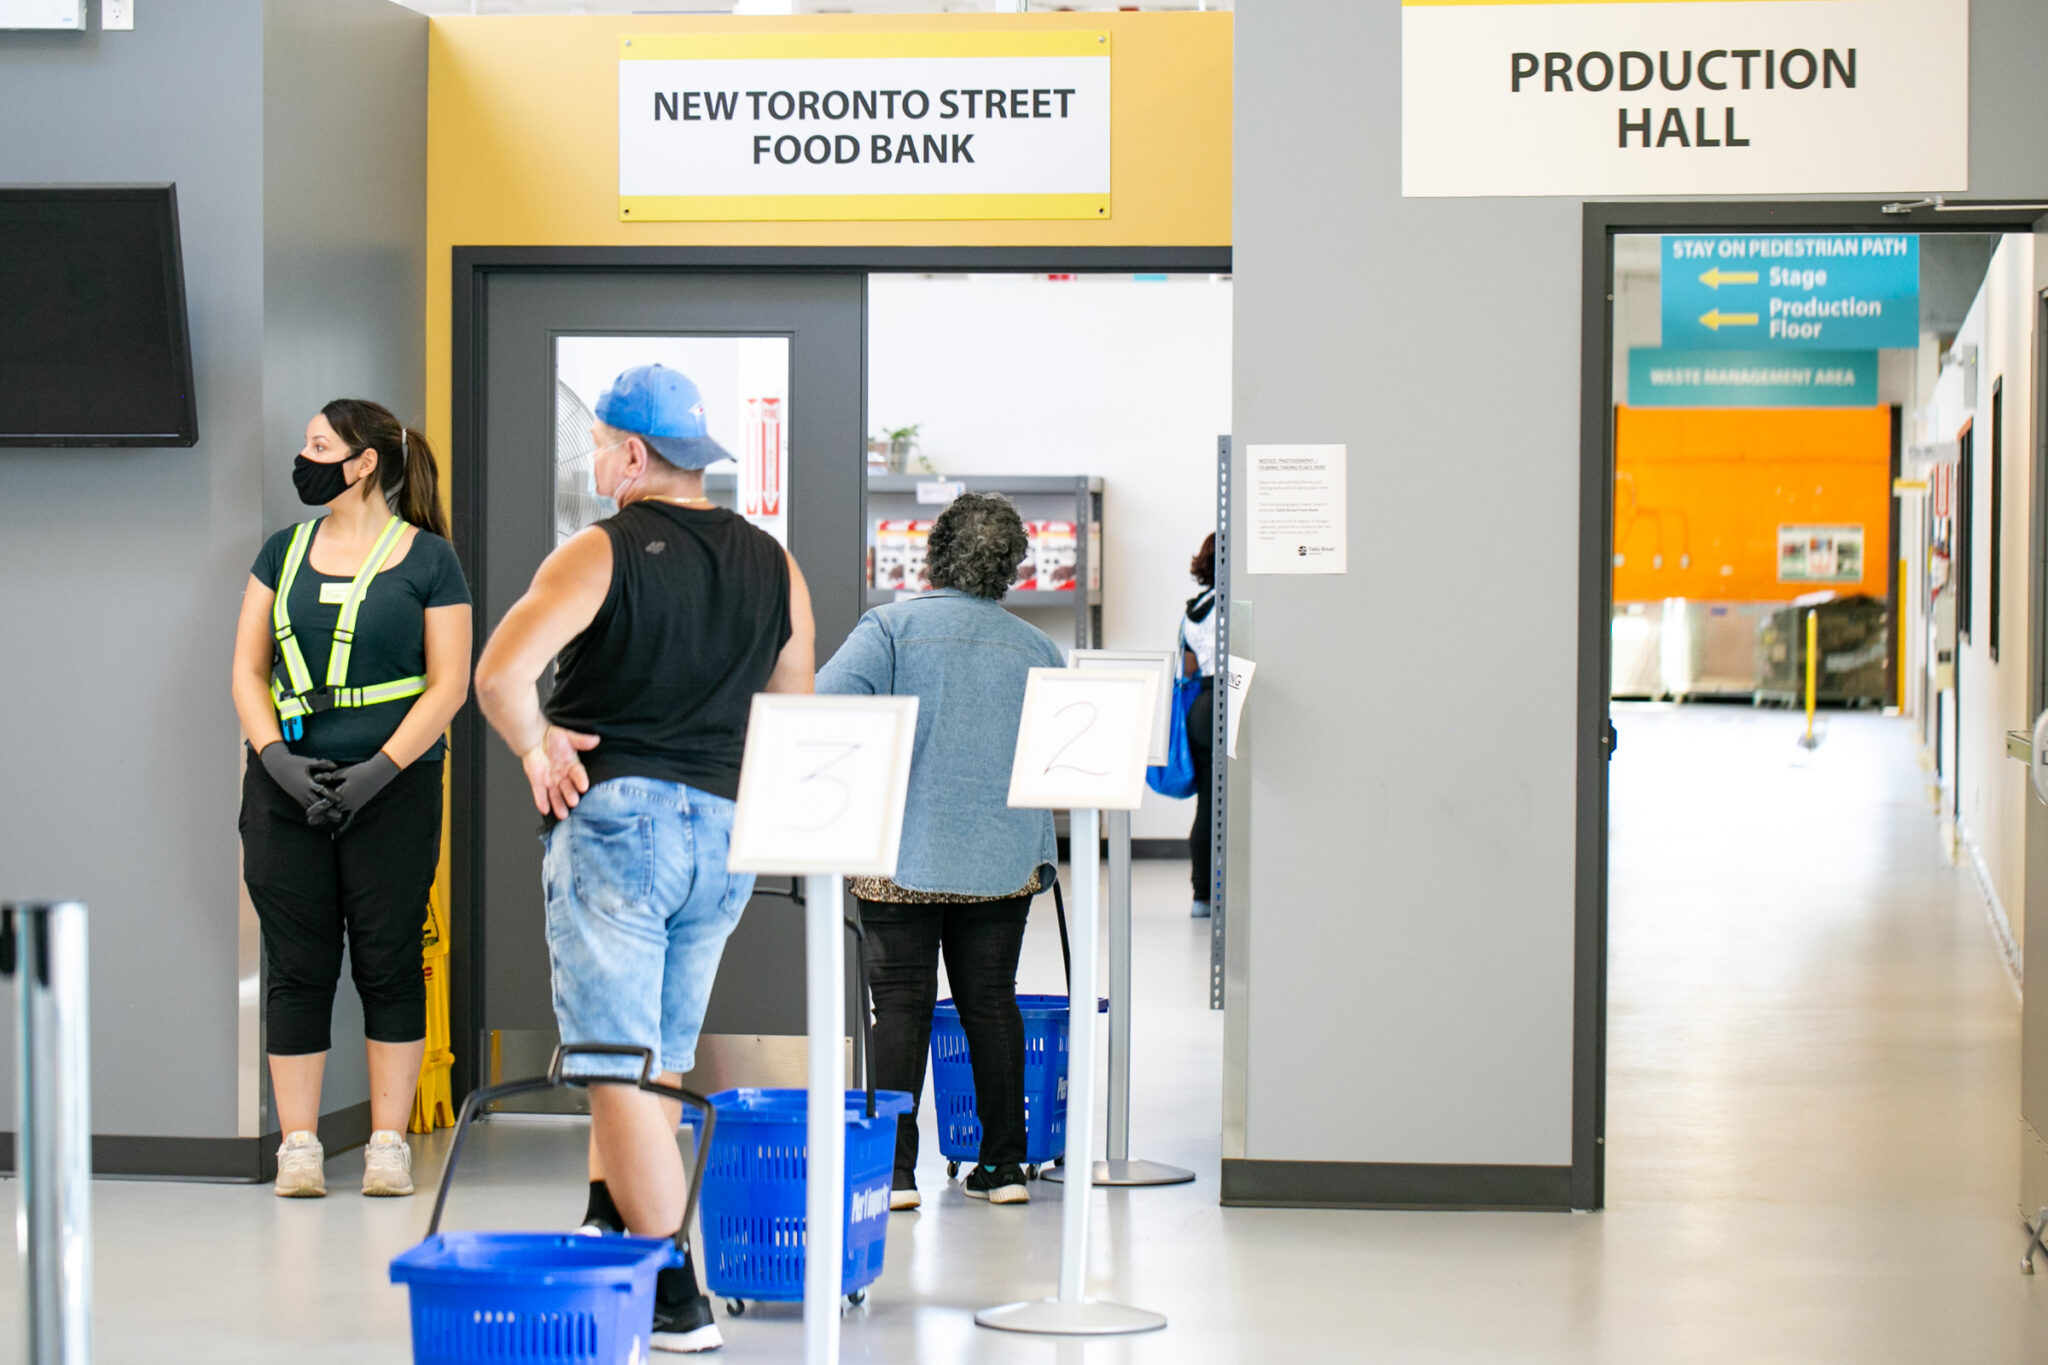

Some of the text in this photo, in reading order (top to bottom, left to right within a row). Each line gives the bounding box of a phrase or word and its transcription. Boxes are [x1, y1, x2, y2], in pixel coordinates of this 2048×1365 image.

[1511, 48, 1856, 93] PRODUCTION
[654, 88, 1076, 121] NEW TORONTO STREET
[1618, 106, 1750, 148] HALL
[753, 133, 975, 165] FOOD BANK
[1672, 237, 1908, 259] STAY ON PEDESTRIAN PATH
[1769, 266, 1827, 290] Stage
[1769, 296, 1882, 318] Production
[1769, 319, 1823, 339] Floor
[1650, 368, 1856, 386] WASTE MANAGEMENT AREA
[1042, 700, 1110, 776] 2
[784, 739, 862, 832] 3
